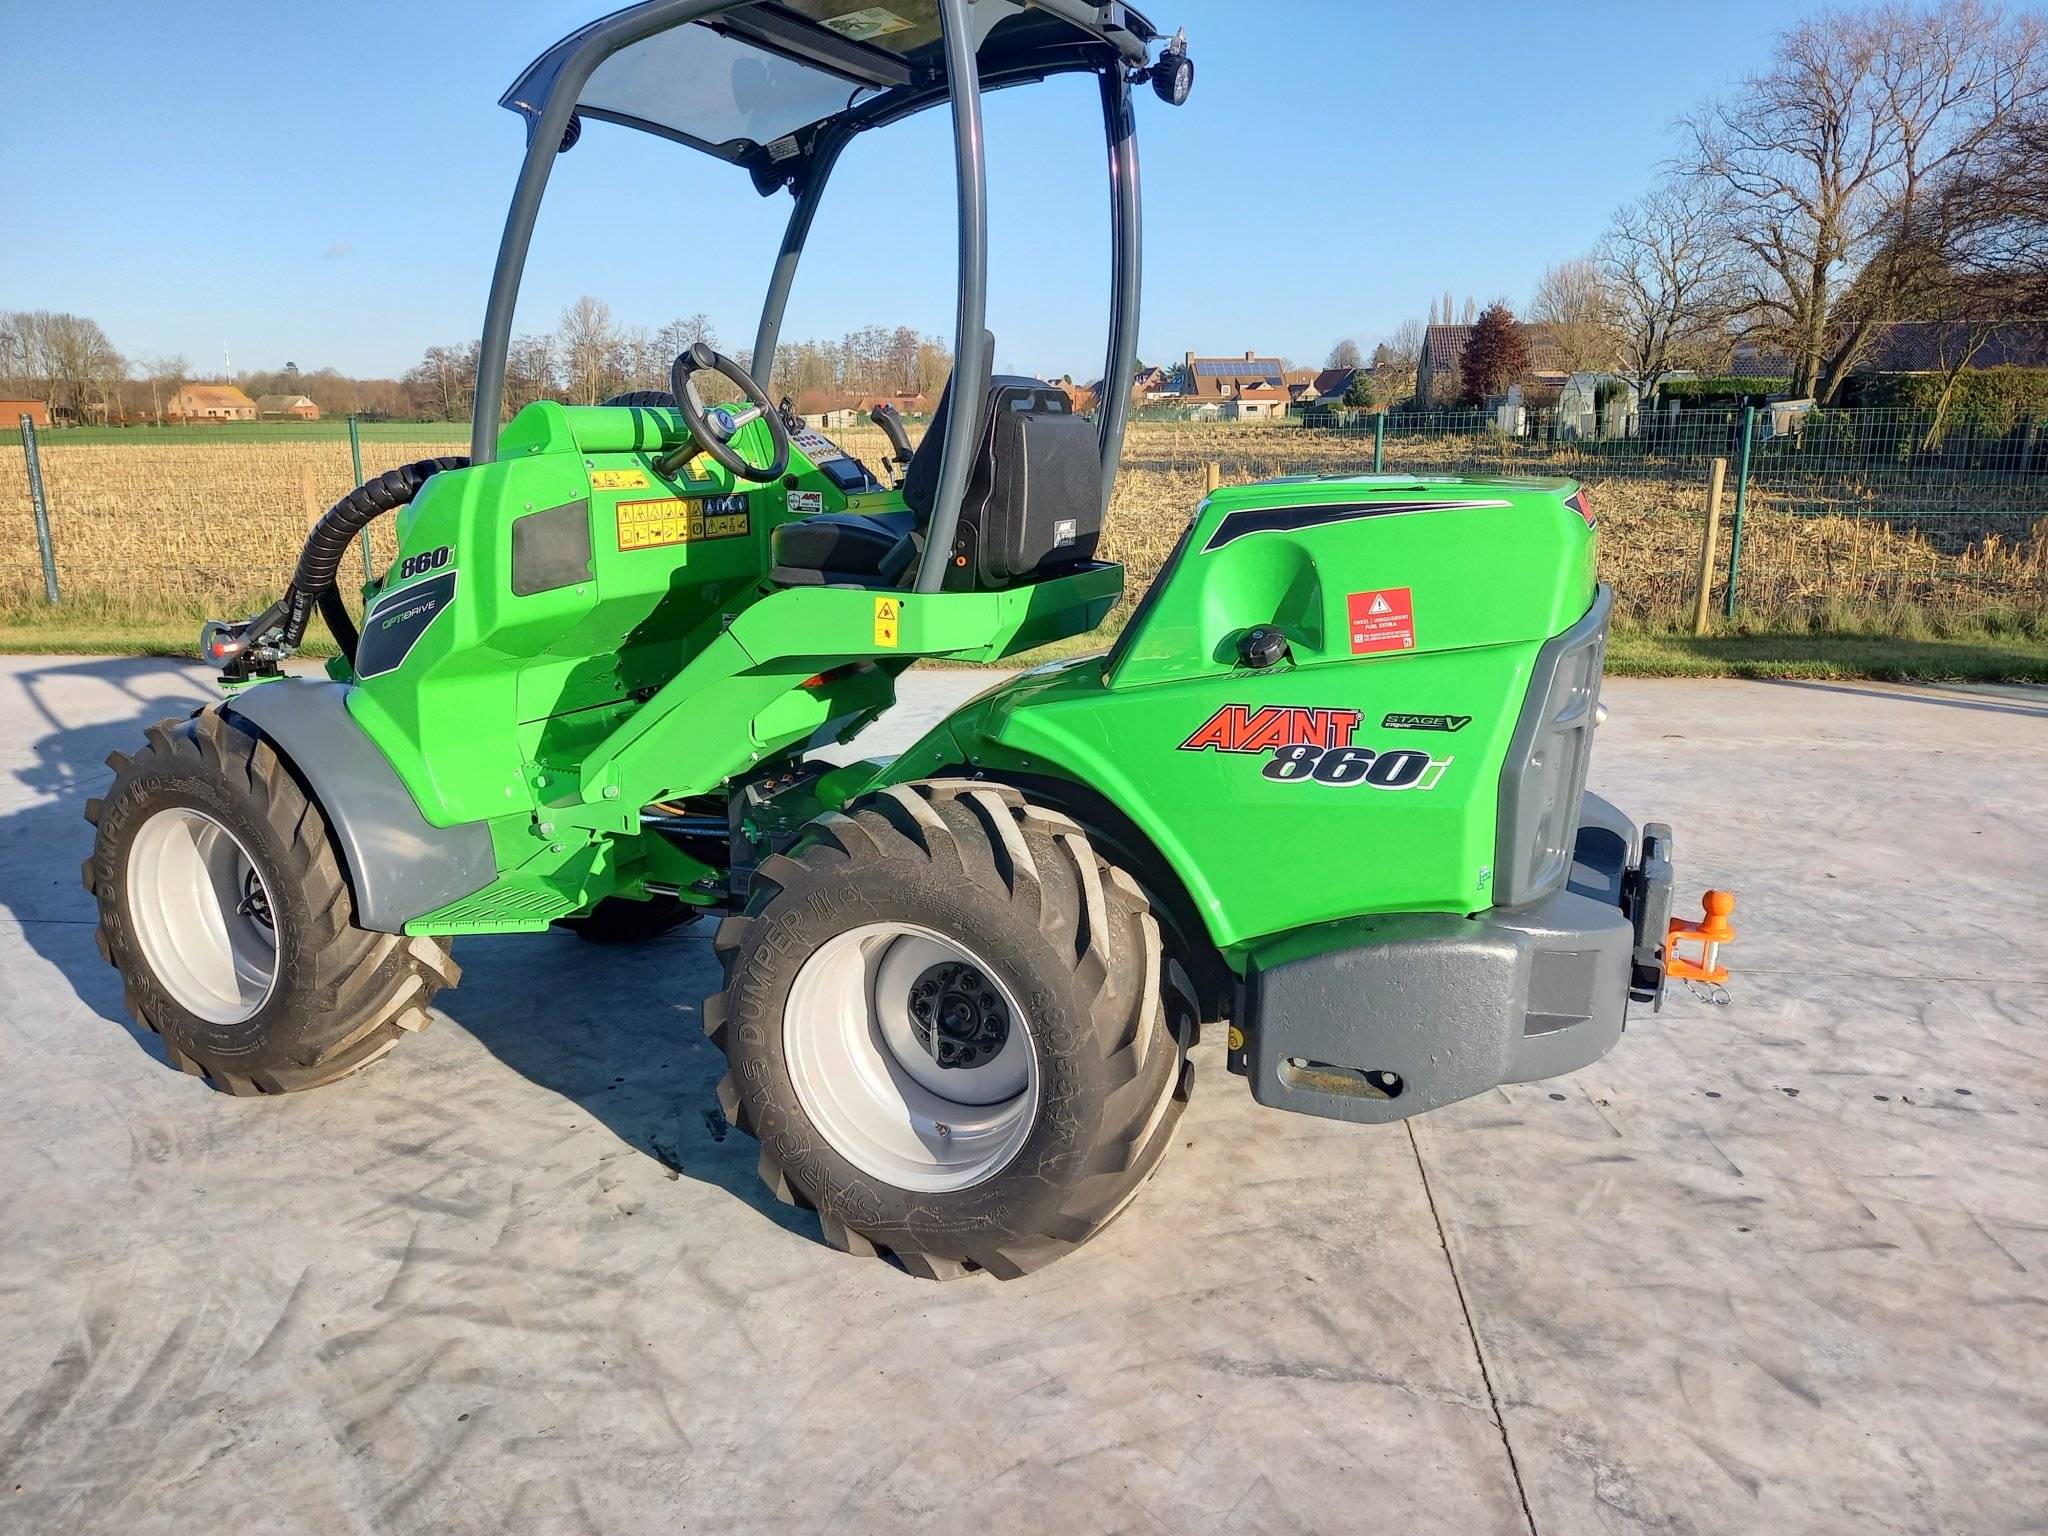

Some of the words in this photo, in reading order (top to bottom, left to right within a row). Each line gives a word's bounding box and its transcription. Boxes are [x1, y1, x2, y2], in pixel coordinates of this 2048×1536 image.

[400, 544, 457, 580] 860i
[381, 599, 436, 630] OPTIDRIVE
[1177, 704, 1360, 753] AVANT
[1386, 715, 1446, 725] STAGE
[1261, 745, 1456, 790] 860i
[737, 908, 804, 1046] DUMPER
